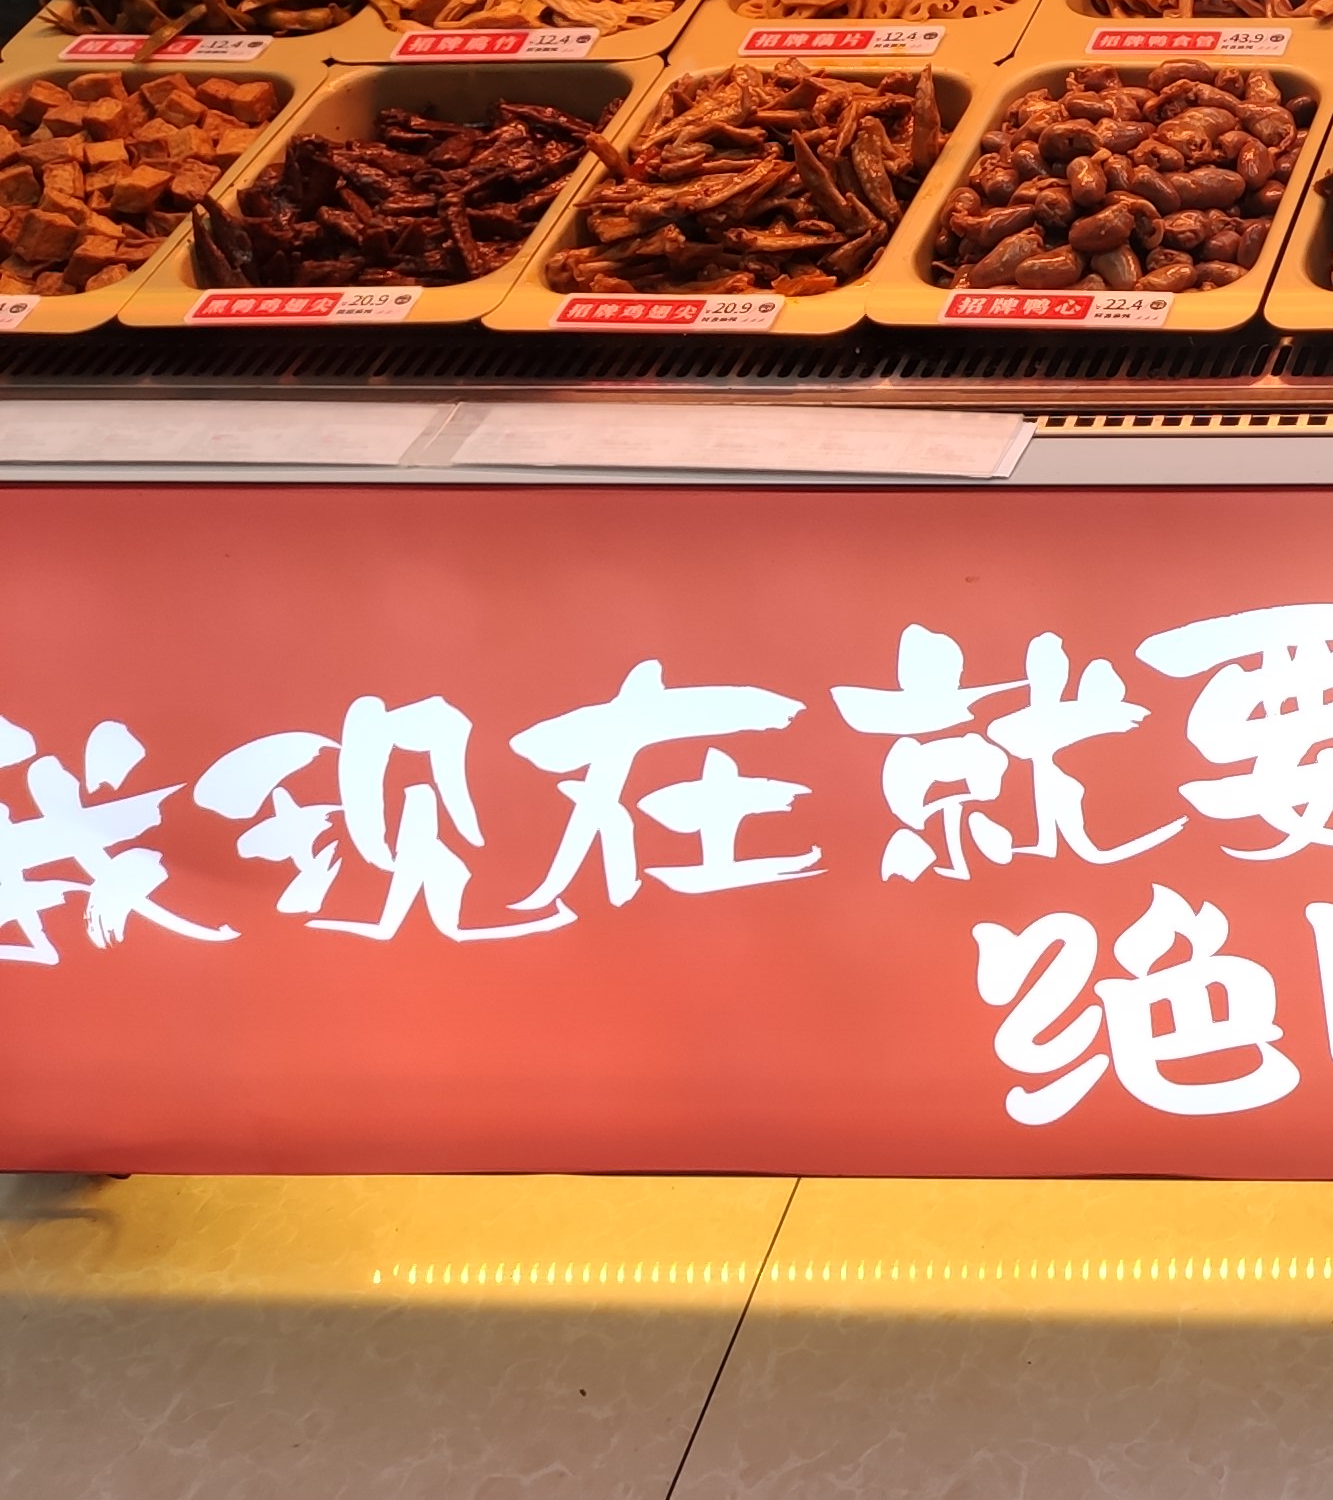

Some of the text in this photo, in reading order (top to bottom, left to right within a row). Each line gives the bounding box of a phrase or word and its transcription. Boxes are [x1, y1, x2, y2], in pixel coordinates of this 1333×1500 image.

[79, 37, 193, 54] 招牌豆
[408, 35, 518, 52] 招牌腐竹
[1100, 34, 1218, 48] 招牌鸭食管
[202, 297, 334, 315] 黑鸭鸡翅尖
[566, 303, 698, 320] 招牌鸡翅尖
[957, 297, 1082, 315] 招牌鸭心
